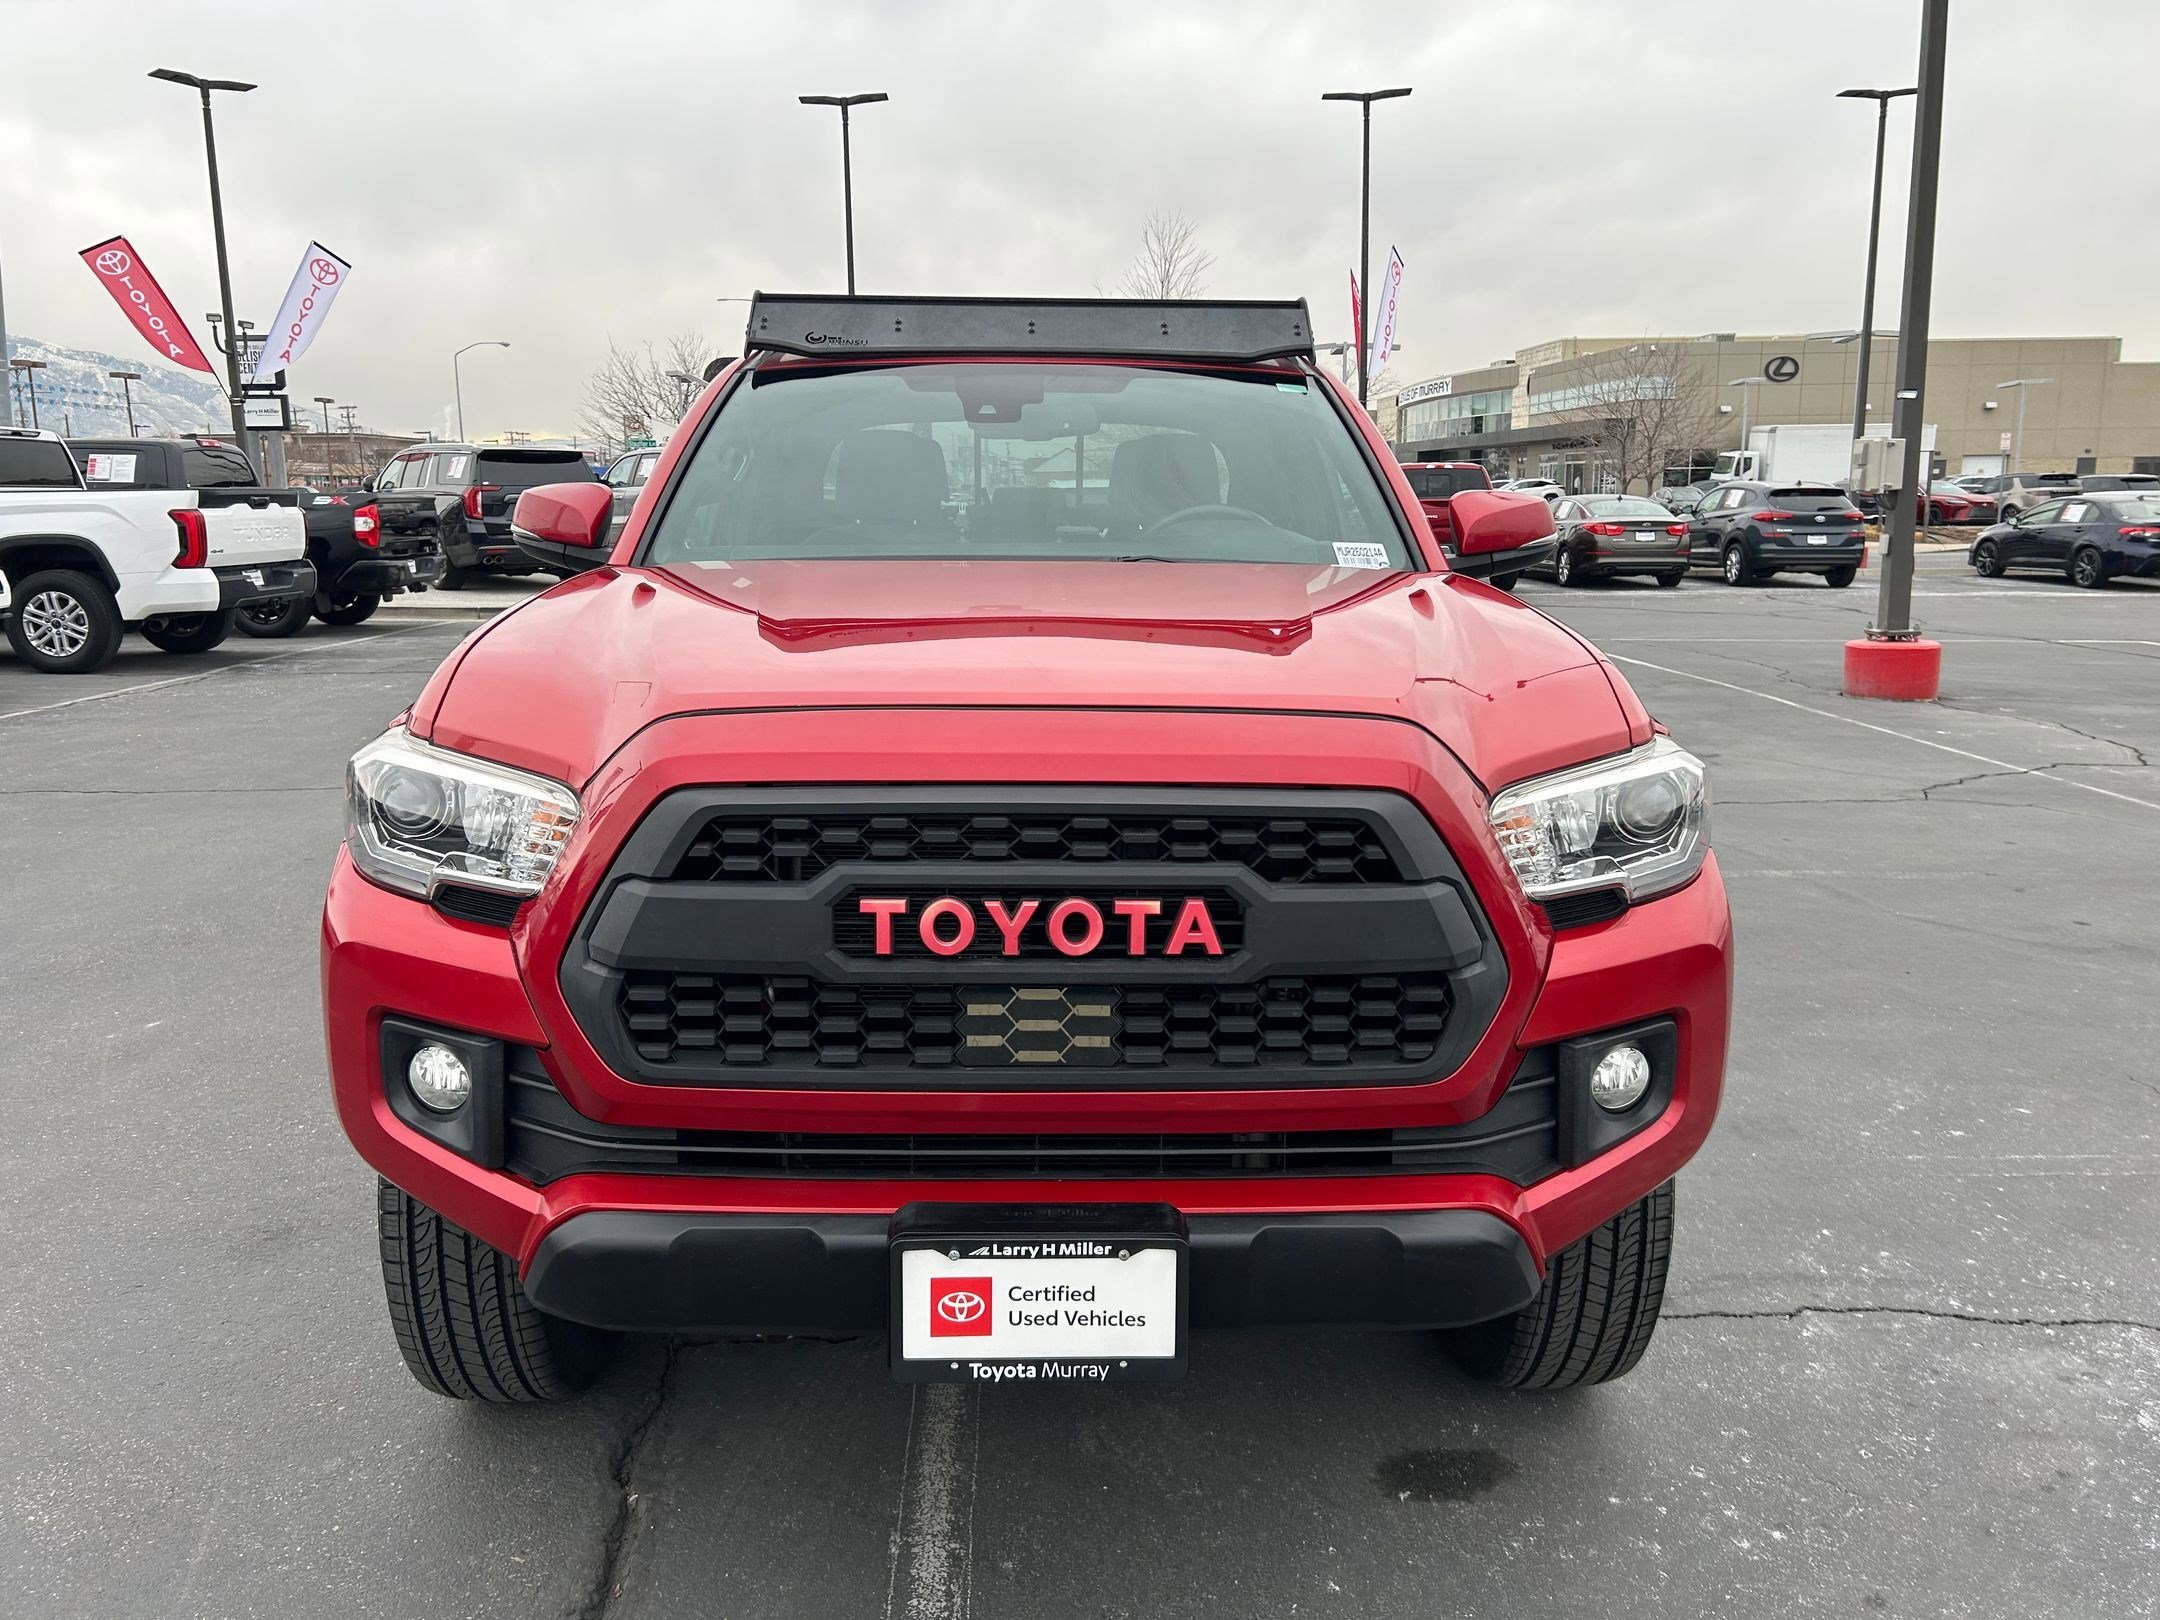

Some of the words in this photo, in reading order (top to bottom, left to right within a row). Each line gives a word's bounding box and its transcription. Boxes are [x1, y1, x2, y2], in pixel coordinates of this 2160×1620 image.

[119, 275, 185, 358] TOYOTA
[279, 283, 321, 364] TOYOTA
[1379, 286, 1397, 363] TOYOTA
[1419, 380, 1451, 398] MURRAY
[232, 526, 291, 543] TUNDRA
[858, 897, 1223, 957] TOYOTA
[992, 1243, 1040, 1258] Larry
[1042, 1243, 1056, 1257] H
[1058, 1242, 1112, 1257] Miller
[1008, 1285, 1095, 1302] Certified
[1009, 1309, 1058, 1327] Used
[1063, 1309, 1146, 1327] Vehicles
[968, 1362, 1037, 1383] Toyota
[1041, 1361, 1110, 1382] Murray
